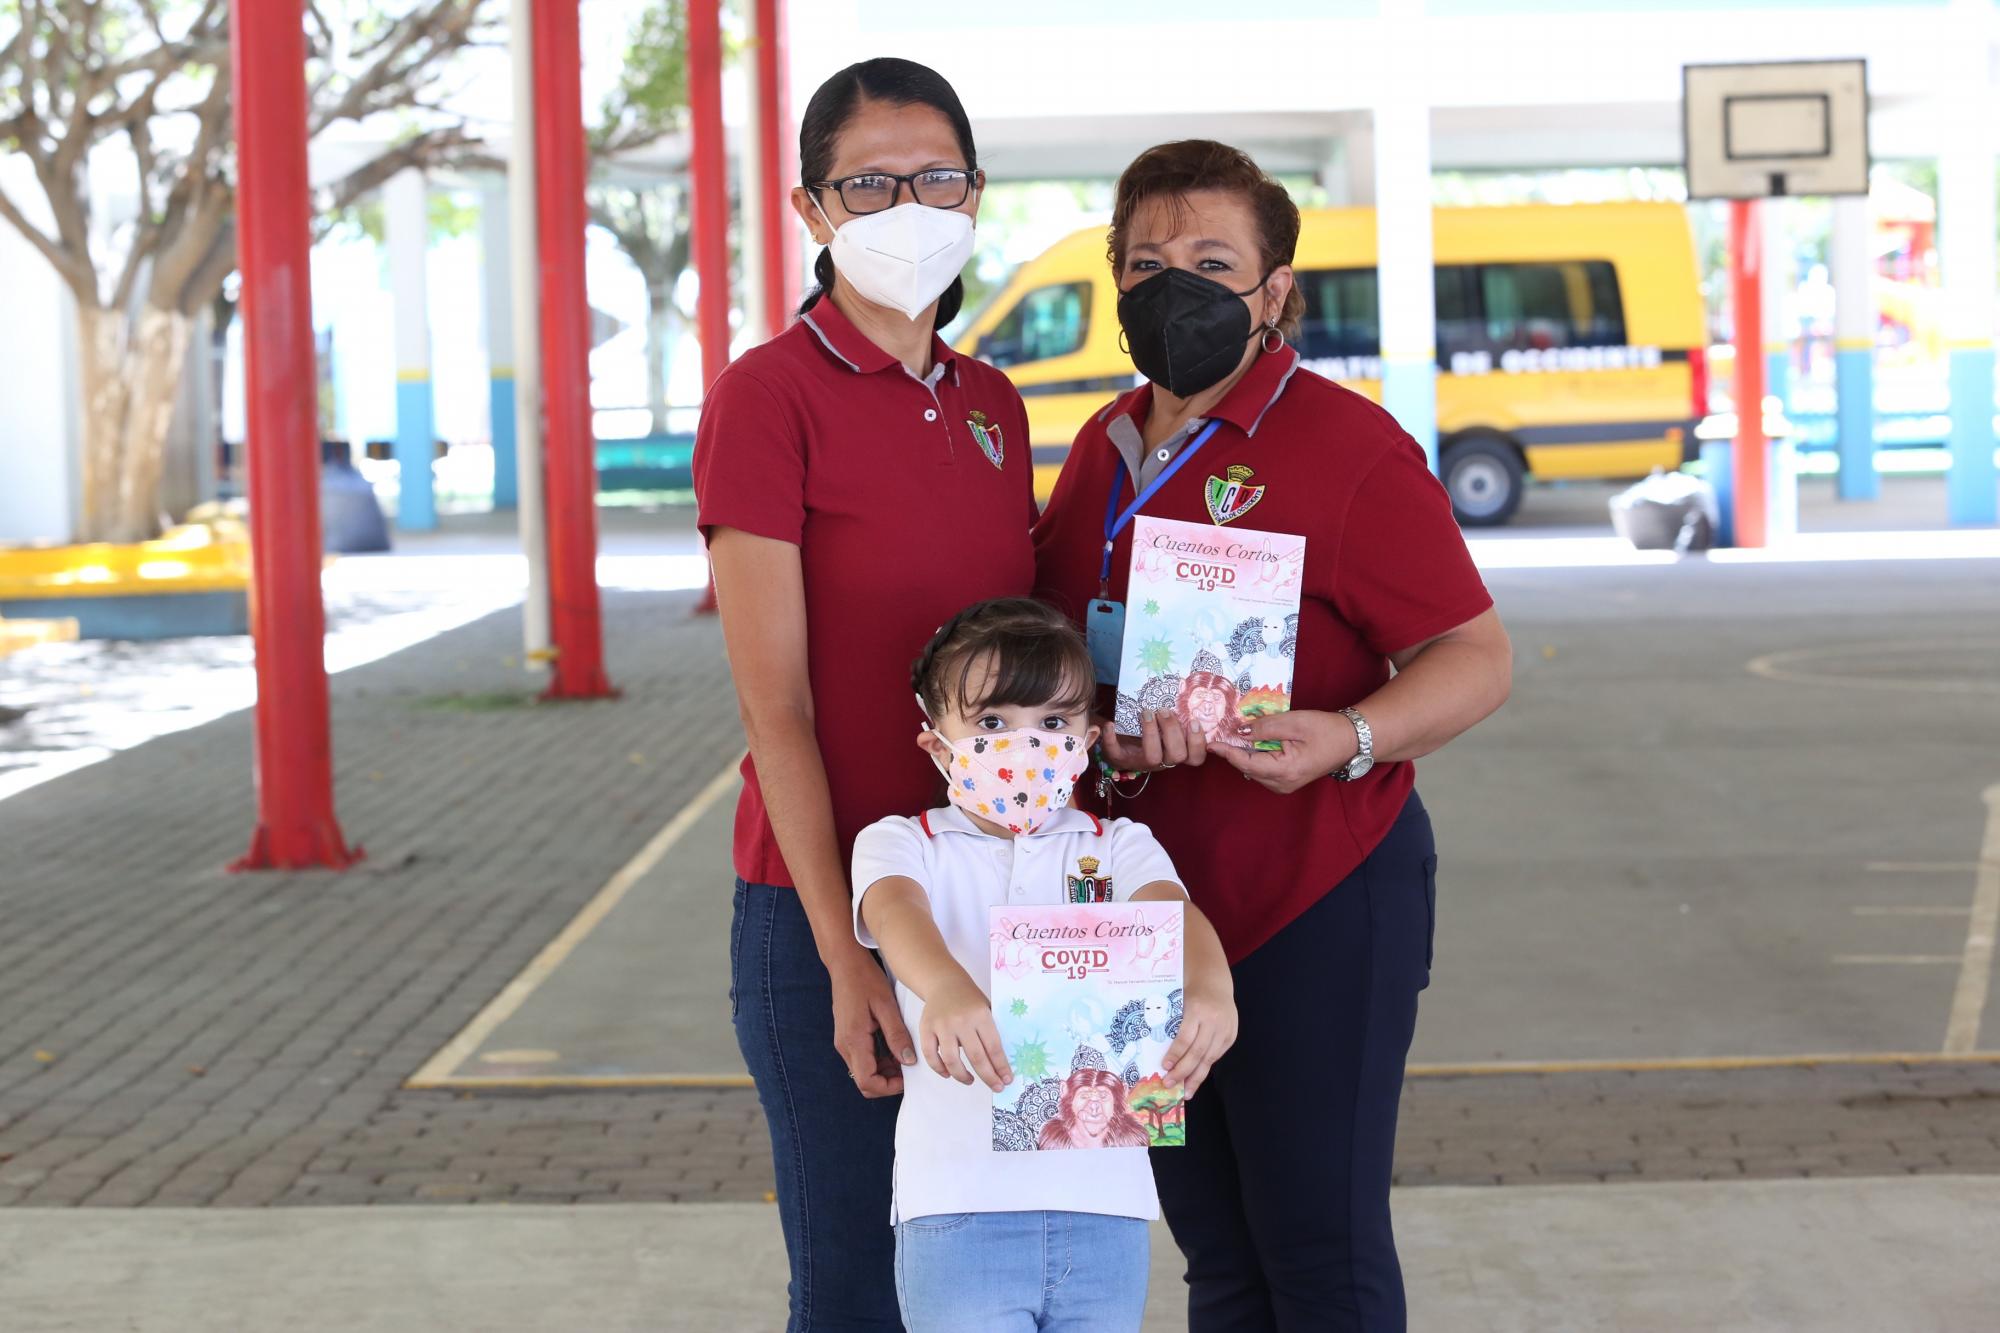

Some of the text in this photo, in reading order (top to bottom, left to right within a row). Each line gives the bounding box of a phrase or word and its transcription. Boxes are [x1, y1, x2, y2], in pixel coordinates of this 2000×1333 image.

[1450, 350, 1492, 375] DE
[1153, 534, 1280, 563] Cuentos Cortos
[1176, 562, 1236, 584] COVID
[1197, 579, 1215, 592] 19
[1012, 920, 1155, 940] Cuentos Cortos
[1041, 950, 1108, 969] COVID
[1067, 966, 1087, 979] 19
